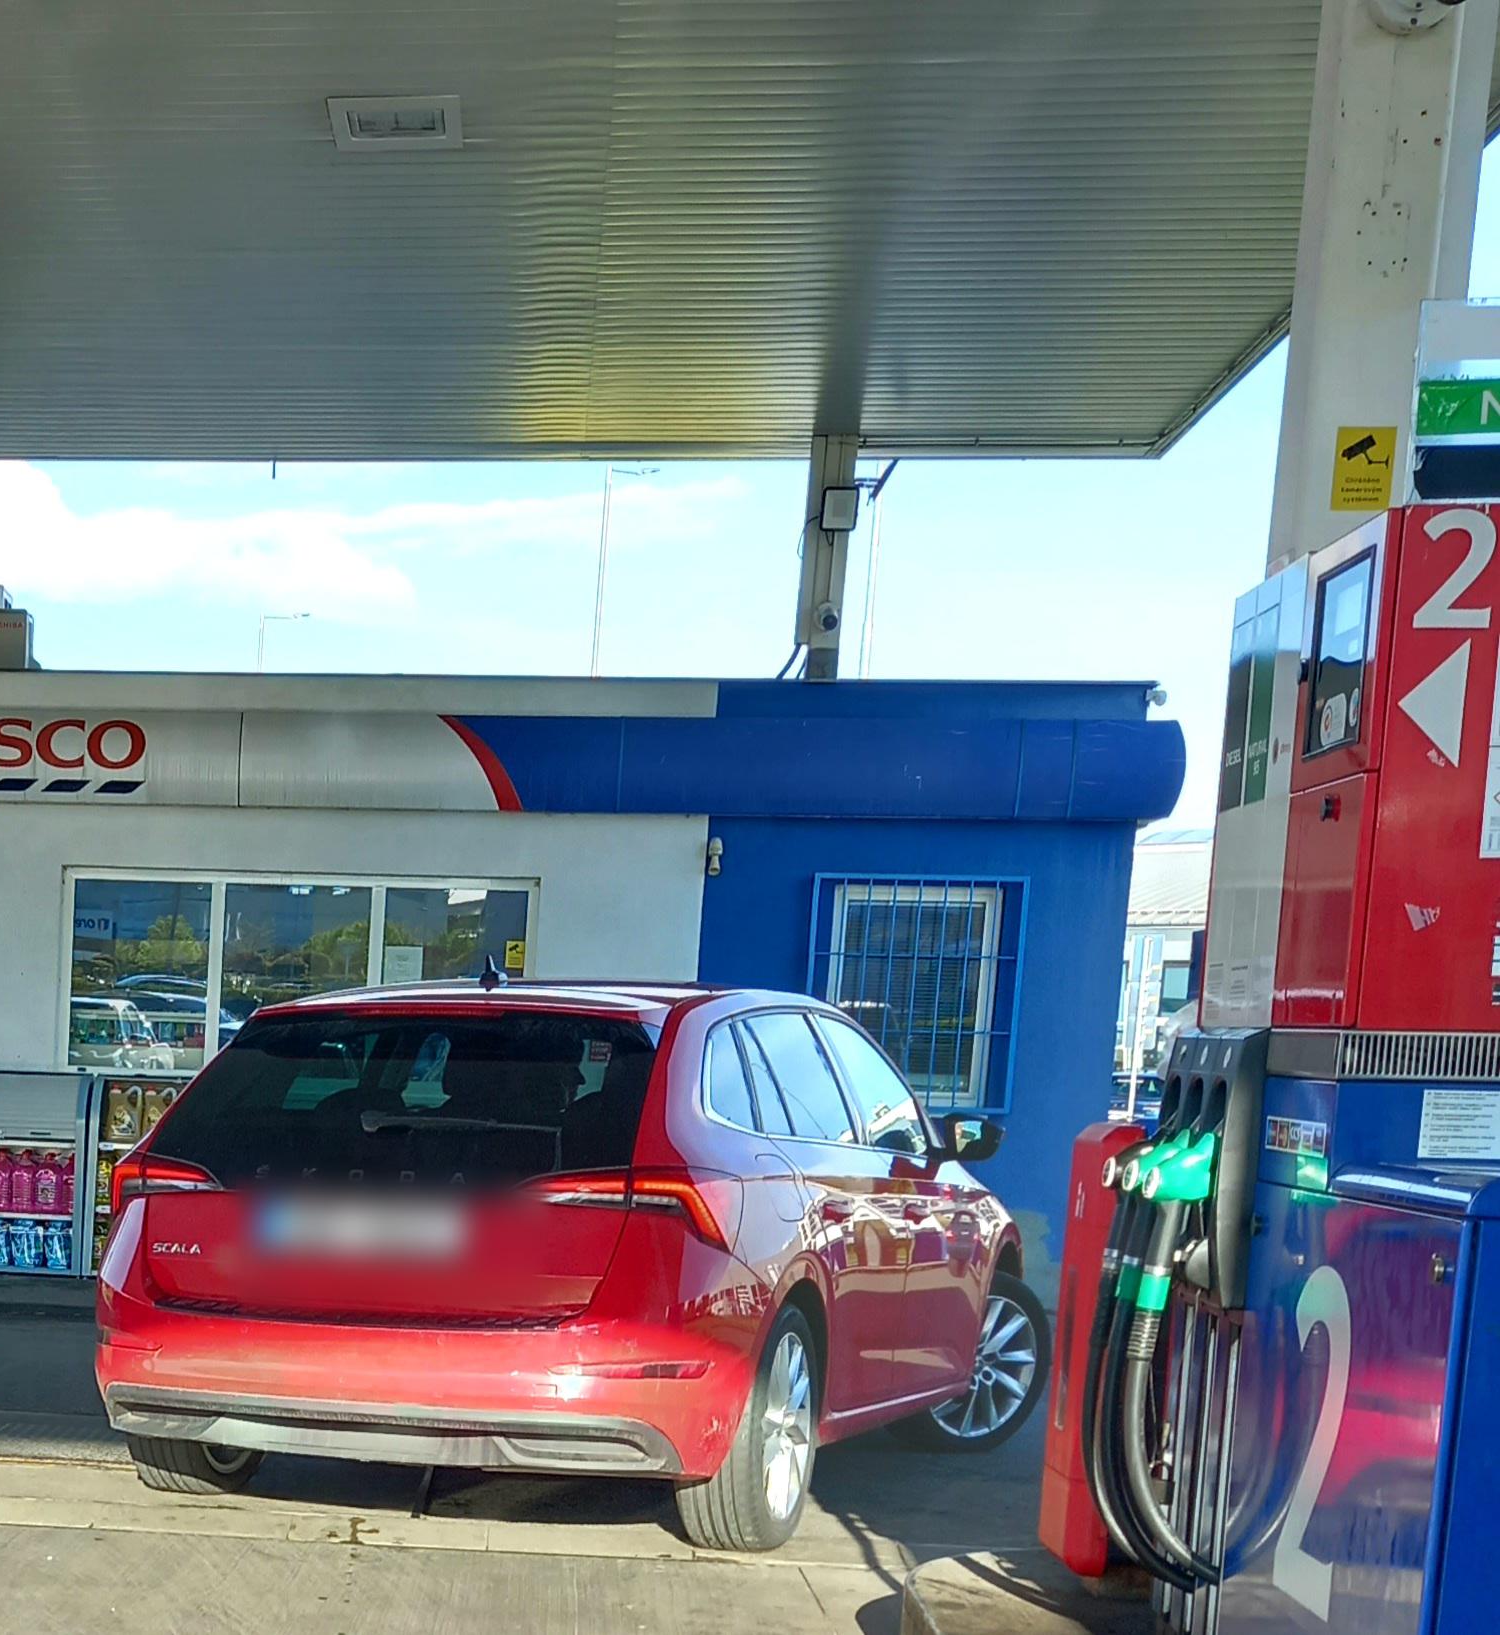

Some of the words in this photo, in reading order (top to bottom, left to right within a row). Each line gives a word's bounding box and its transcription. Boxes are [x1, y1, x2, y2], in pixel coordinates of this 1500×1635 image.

[1412, 508, 1497, 628] 2
[255, 1164, 466, 1185] ŠKODA
[152, 1242, 201, 1255] SCALA
[1273, 1266, 1351, 1623] 2
